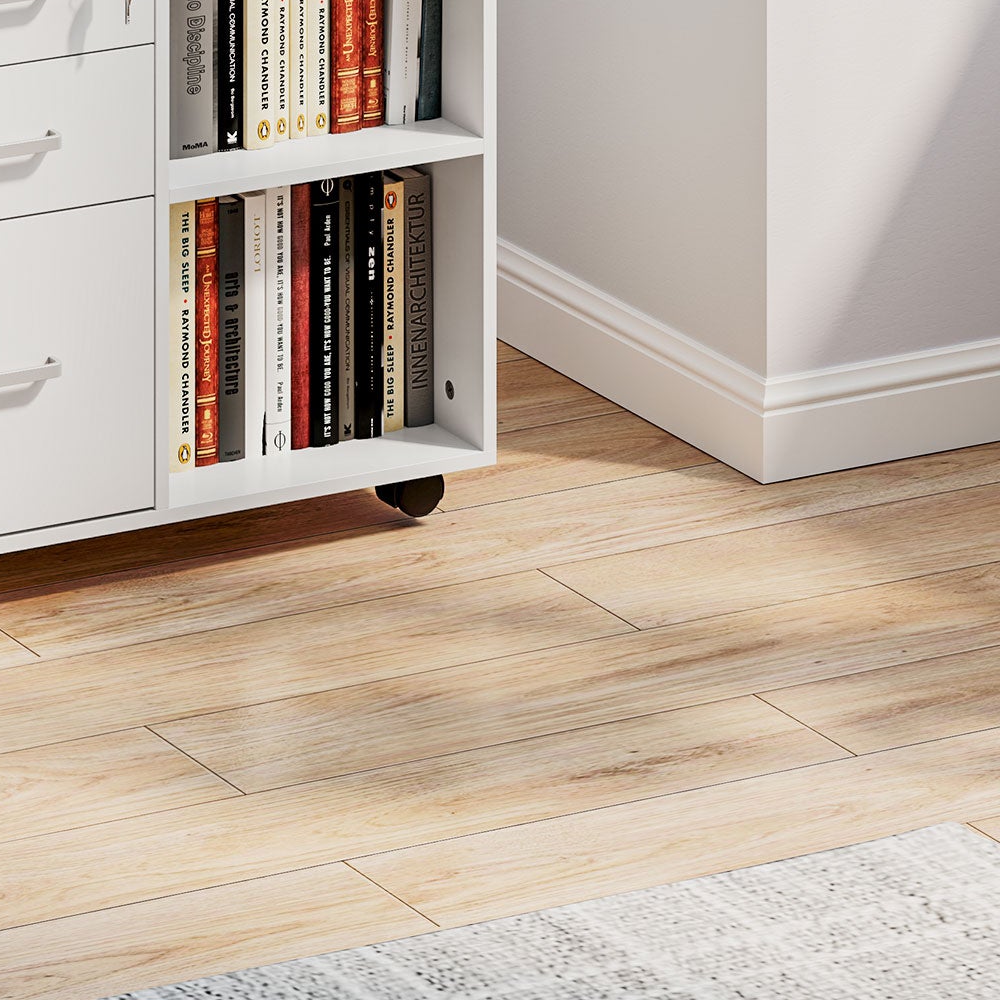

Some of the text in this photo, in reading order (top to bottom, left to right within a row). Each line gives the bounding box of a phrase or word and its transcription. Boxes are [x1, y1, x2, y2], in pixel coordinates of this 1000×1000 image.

[228, 12, 236, 83] COMMUNICATION
[182, 15, 206, 95] Discipline
[261, 49, 269, 110] CHANDLER
[182, 141, 208, 151] MoMA
[276, 208, 284, 219] NOT
[276, 221, 284, 233] HOW
[323, 233, 332, 246] Paul
[276, 252, 284, 263] YOU
[323, 267, 332, 275] TO
[225, 271, 240, 298] arts
[323, 277, 332, 292] WANT
[407, 192, 428, 390] INNENARCHITEKTUR
[276, 293, 284, 305] HOW
[323, 294, 332, 306] YOU
[181, 212, 189, 434] THE BIG SLEEP RAYMOND CHANDLER
[276, 323, 284, 335] YOU
[323, 325, 332, 338] HOW
[276, 337, 284, 352] WANT
[225, 318, 241, 396] architecture
[276, 354, 284, 362] TO
[323, 368, 332, 379] YOU
[276, 381, 284, 394] Paul
[323, 398, 332, 411] HOW
[323, 413, 332, 424] NOT
